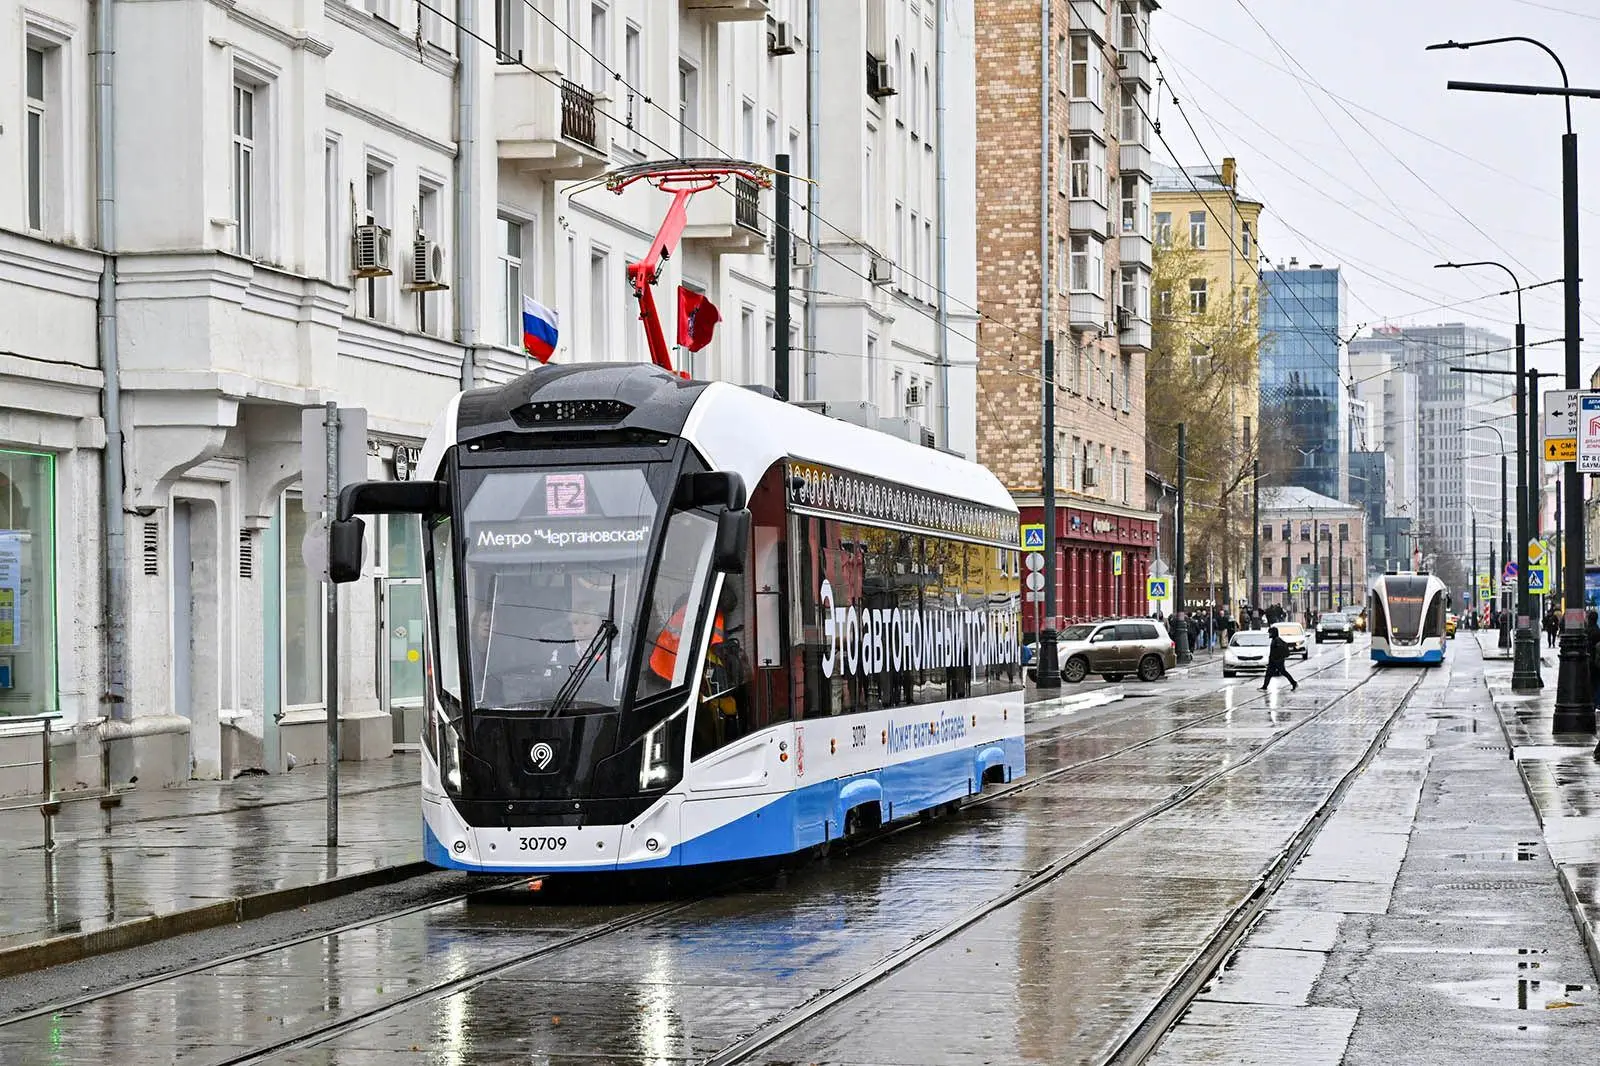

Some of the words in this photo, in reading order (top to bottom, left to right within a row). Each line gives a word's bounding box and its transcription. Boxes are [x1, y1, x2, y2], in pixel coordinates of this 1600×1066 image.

[546, 482, 585, 510] Т2
[477, 529, 532, 547] Метро
[534, 526, 650, 546] "Чертановская"
[820, 578, 858, 679] Это
[862, 592, 964, 677] автономный
[886, 719, 912, 755] Может
[519, 837, 567, 851] 30709
